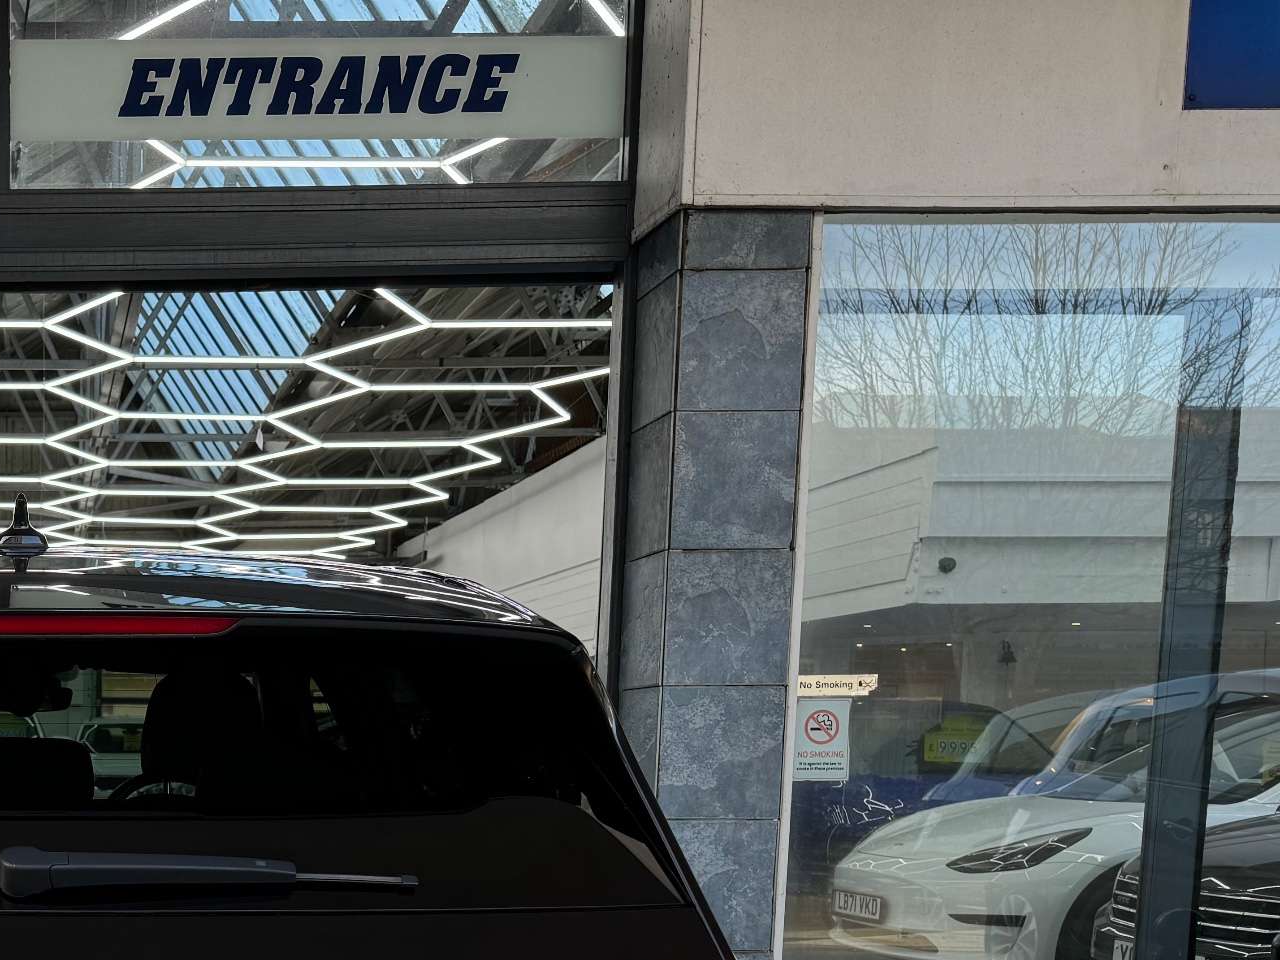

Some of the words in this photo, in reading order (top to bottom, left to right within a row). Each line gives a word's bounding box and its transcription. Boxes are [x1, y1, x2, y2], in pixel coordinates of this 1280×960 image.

[117, 53, 521, 118] ENTRANCE
[799, 681, 812, 689] No
[815, 680, 853, 690] Smoking
[797, 750, 808, 758] NO
[810, 750, 844, 758] SMOKING
